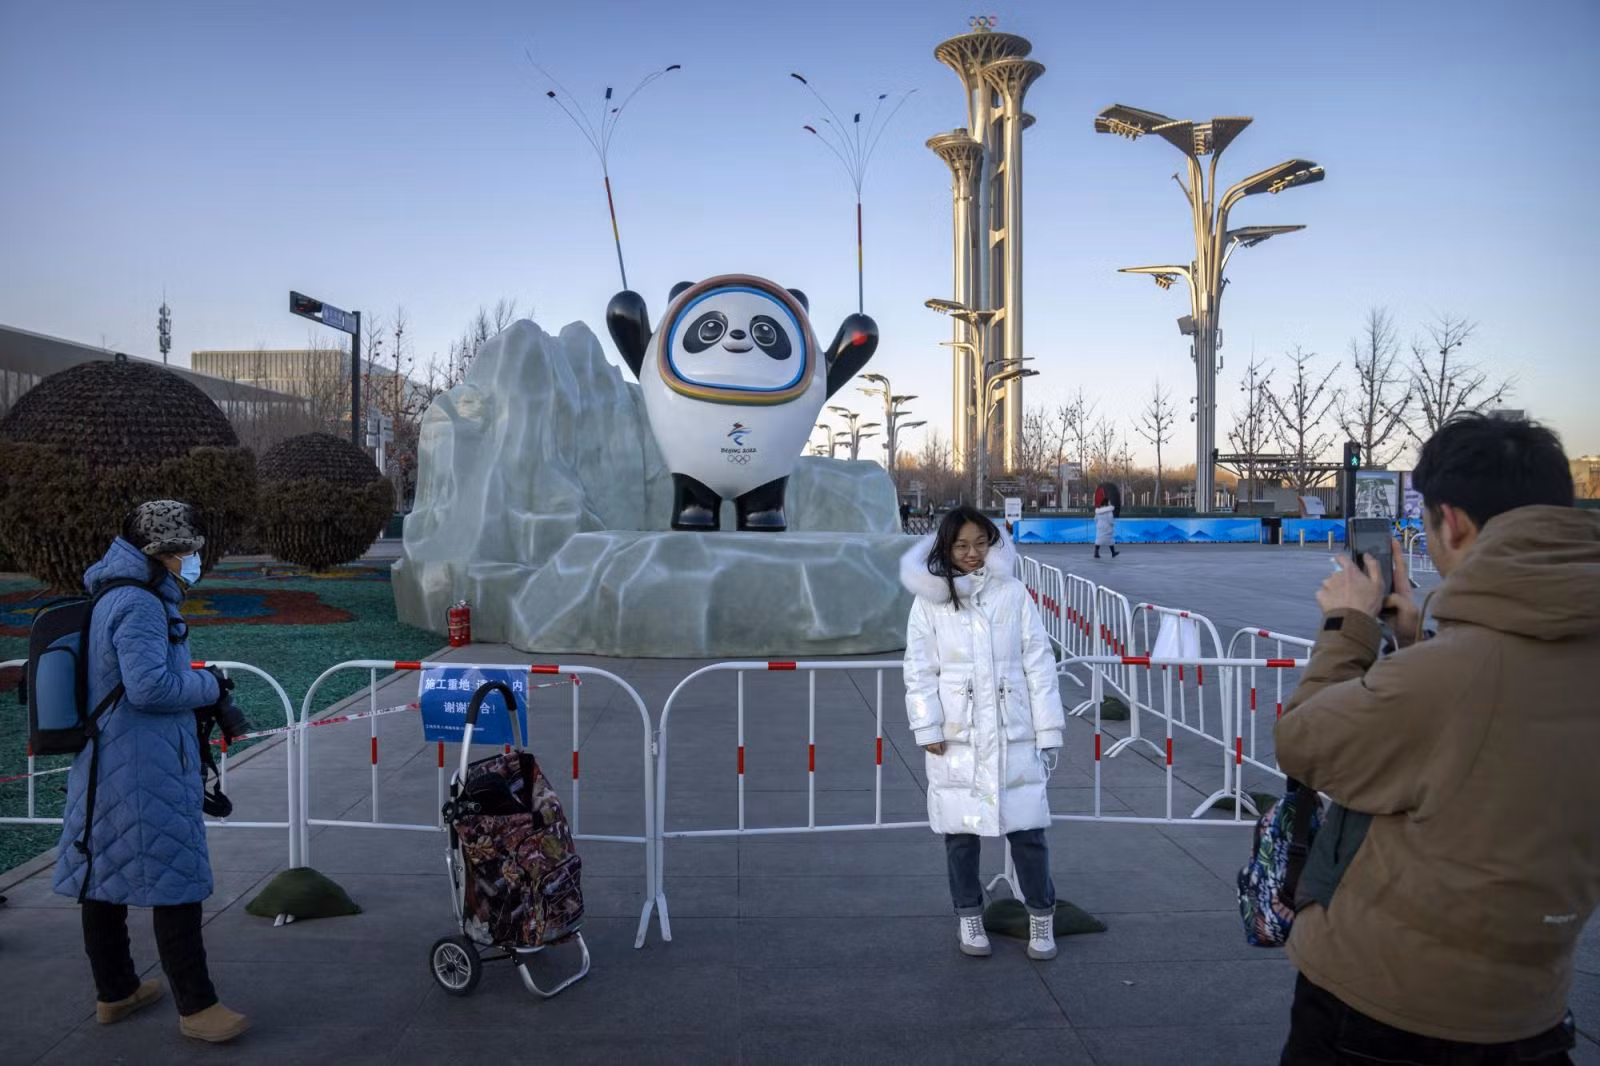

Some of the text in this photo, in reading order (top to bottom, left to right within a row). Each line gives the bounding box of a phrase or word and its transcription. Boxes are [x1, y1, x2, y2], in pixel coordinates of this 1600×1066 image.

[425, 678, 470, 691] 施工重地
[443, 701, 496, 714] 谢谢合！
